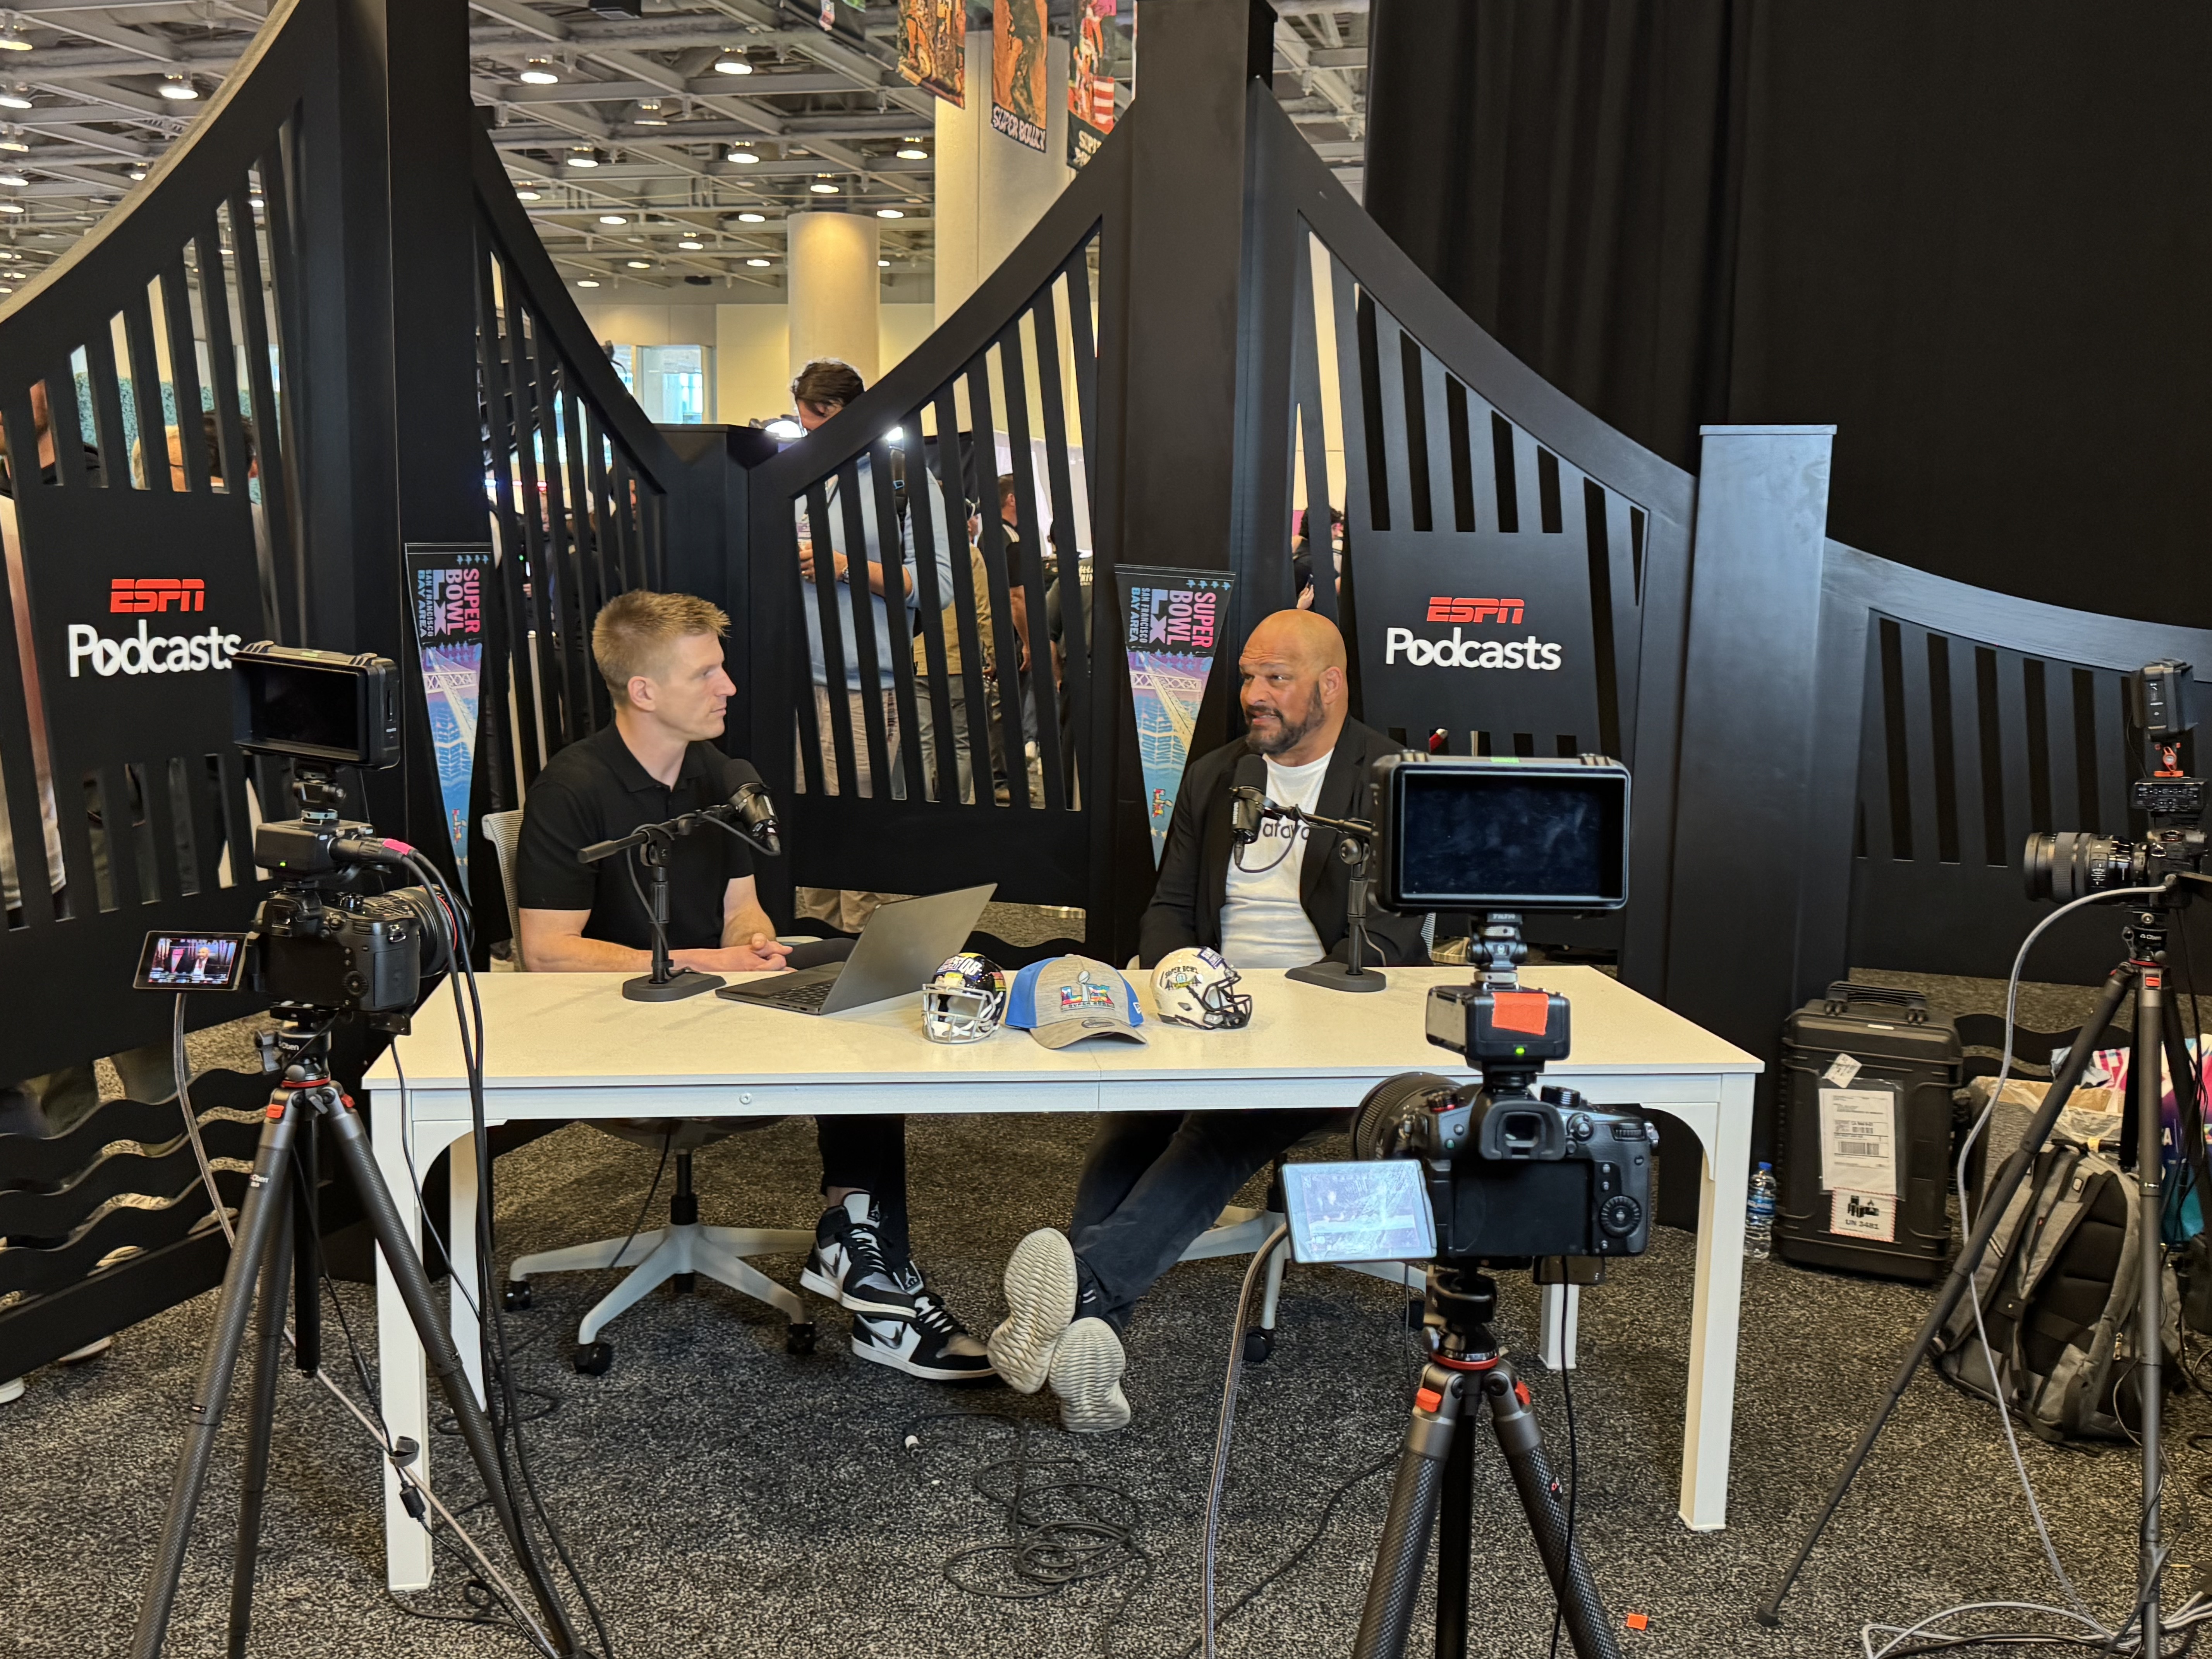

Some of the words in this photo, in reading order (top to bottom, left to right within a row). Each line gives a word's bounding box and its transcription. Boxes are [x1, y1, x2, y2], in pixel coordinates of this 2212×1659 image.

[110, 579, 205, 613] ESPN
[417, 570, 426, 598] BAY
[433, 569, 447, 637] LX
[445, 569, 464, 635] BOWL
[464, 568, 481, 633] SUPER
[1130, 587, 1141, 610] BAY
[1141, 587, 1151, 602] SAN
[418, 599, 428, 638] AREA
[1129, 611, 1140, 642] AREA
[1139, 604, 1150, 643] FRANCISCO
[1149, 589, 1168, 644] LX
[1166, 590, 1193, 645] BOWL
[1191, 592, 1216, 649] SUPER
[1426, 597, 1525, 624] ESPN
[68, 619, 242, 678] Podcasts
[1386, 627, 1562, 670] Podcasts
